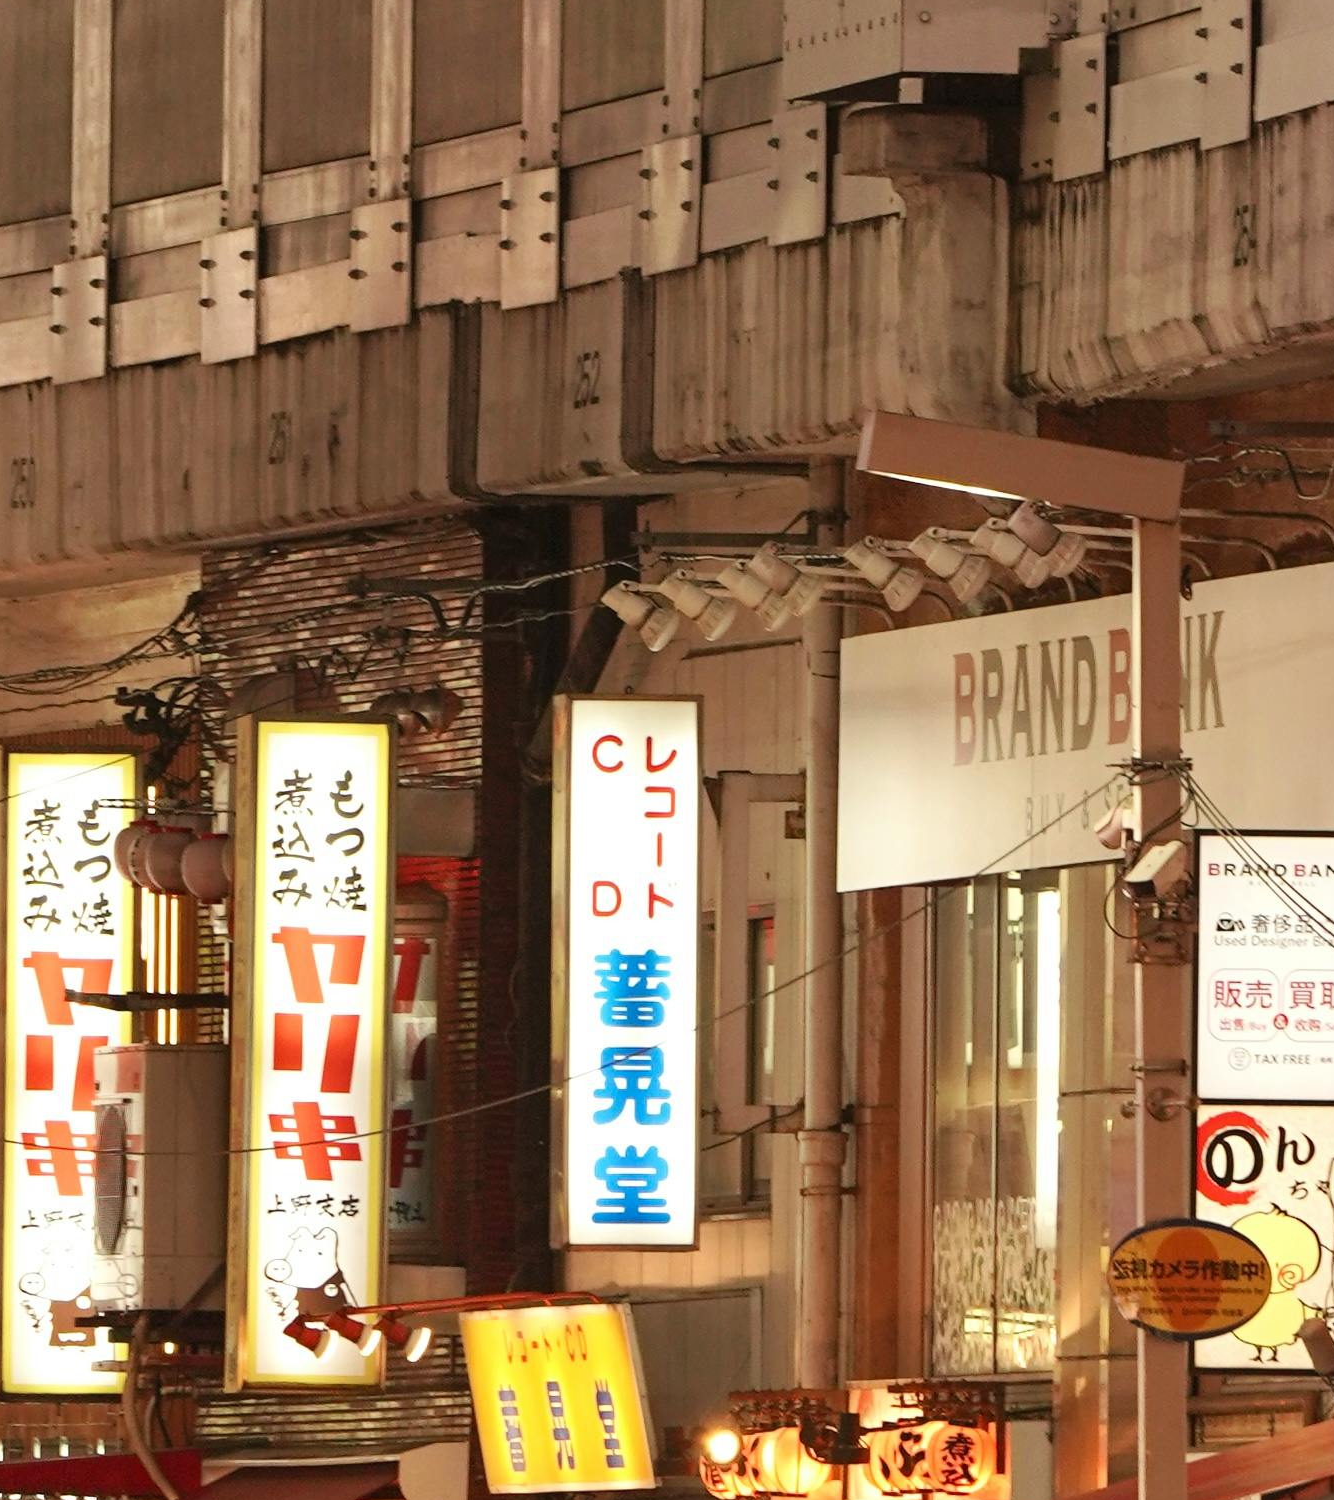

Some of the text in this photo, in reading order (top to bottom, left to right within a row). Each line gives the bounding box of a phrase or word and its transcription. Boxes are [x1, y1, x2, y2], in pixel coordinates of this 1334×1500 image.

[952, 633, 1099, 768] BRAND
[1208, 863, 1287, 878] BRAND
[1213, 979, 1273, 1010] 販売
[267, 925, 367, 1181] ヤリキ
[1282, 1053, 1311, 1065] FREE
[592, 949, 674, 1224] 蓄晃堂
[1205, 1125, 1316, 1189] のん
